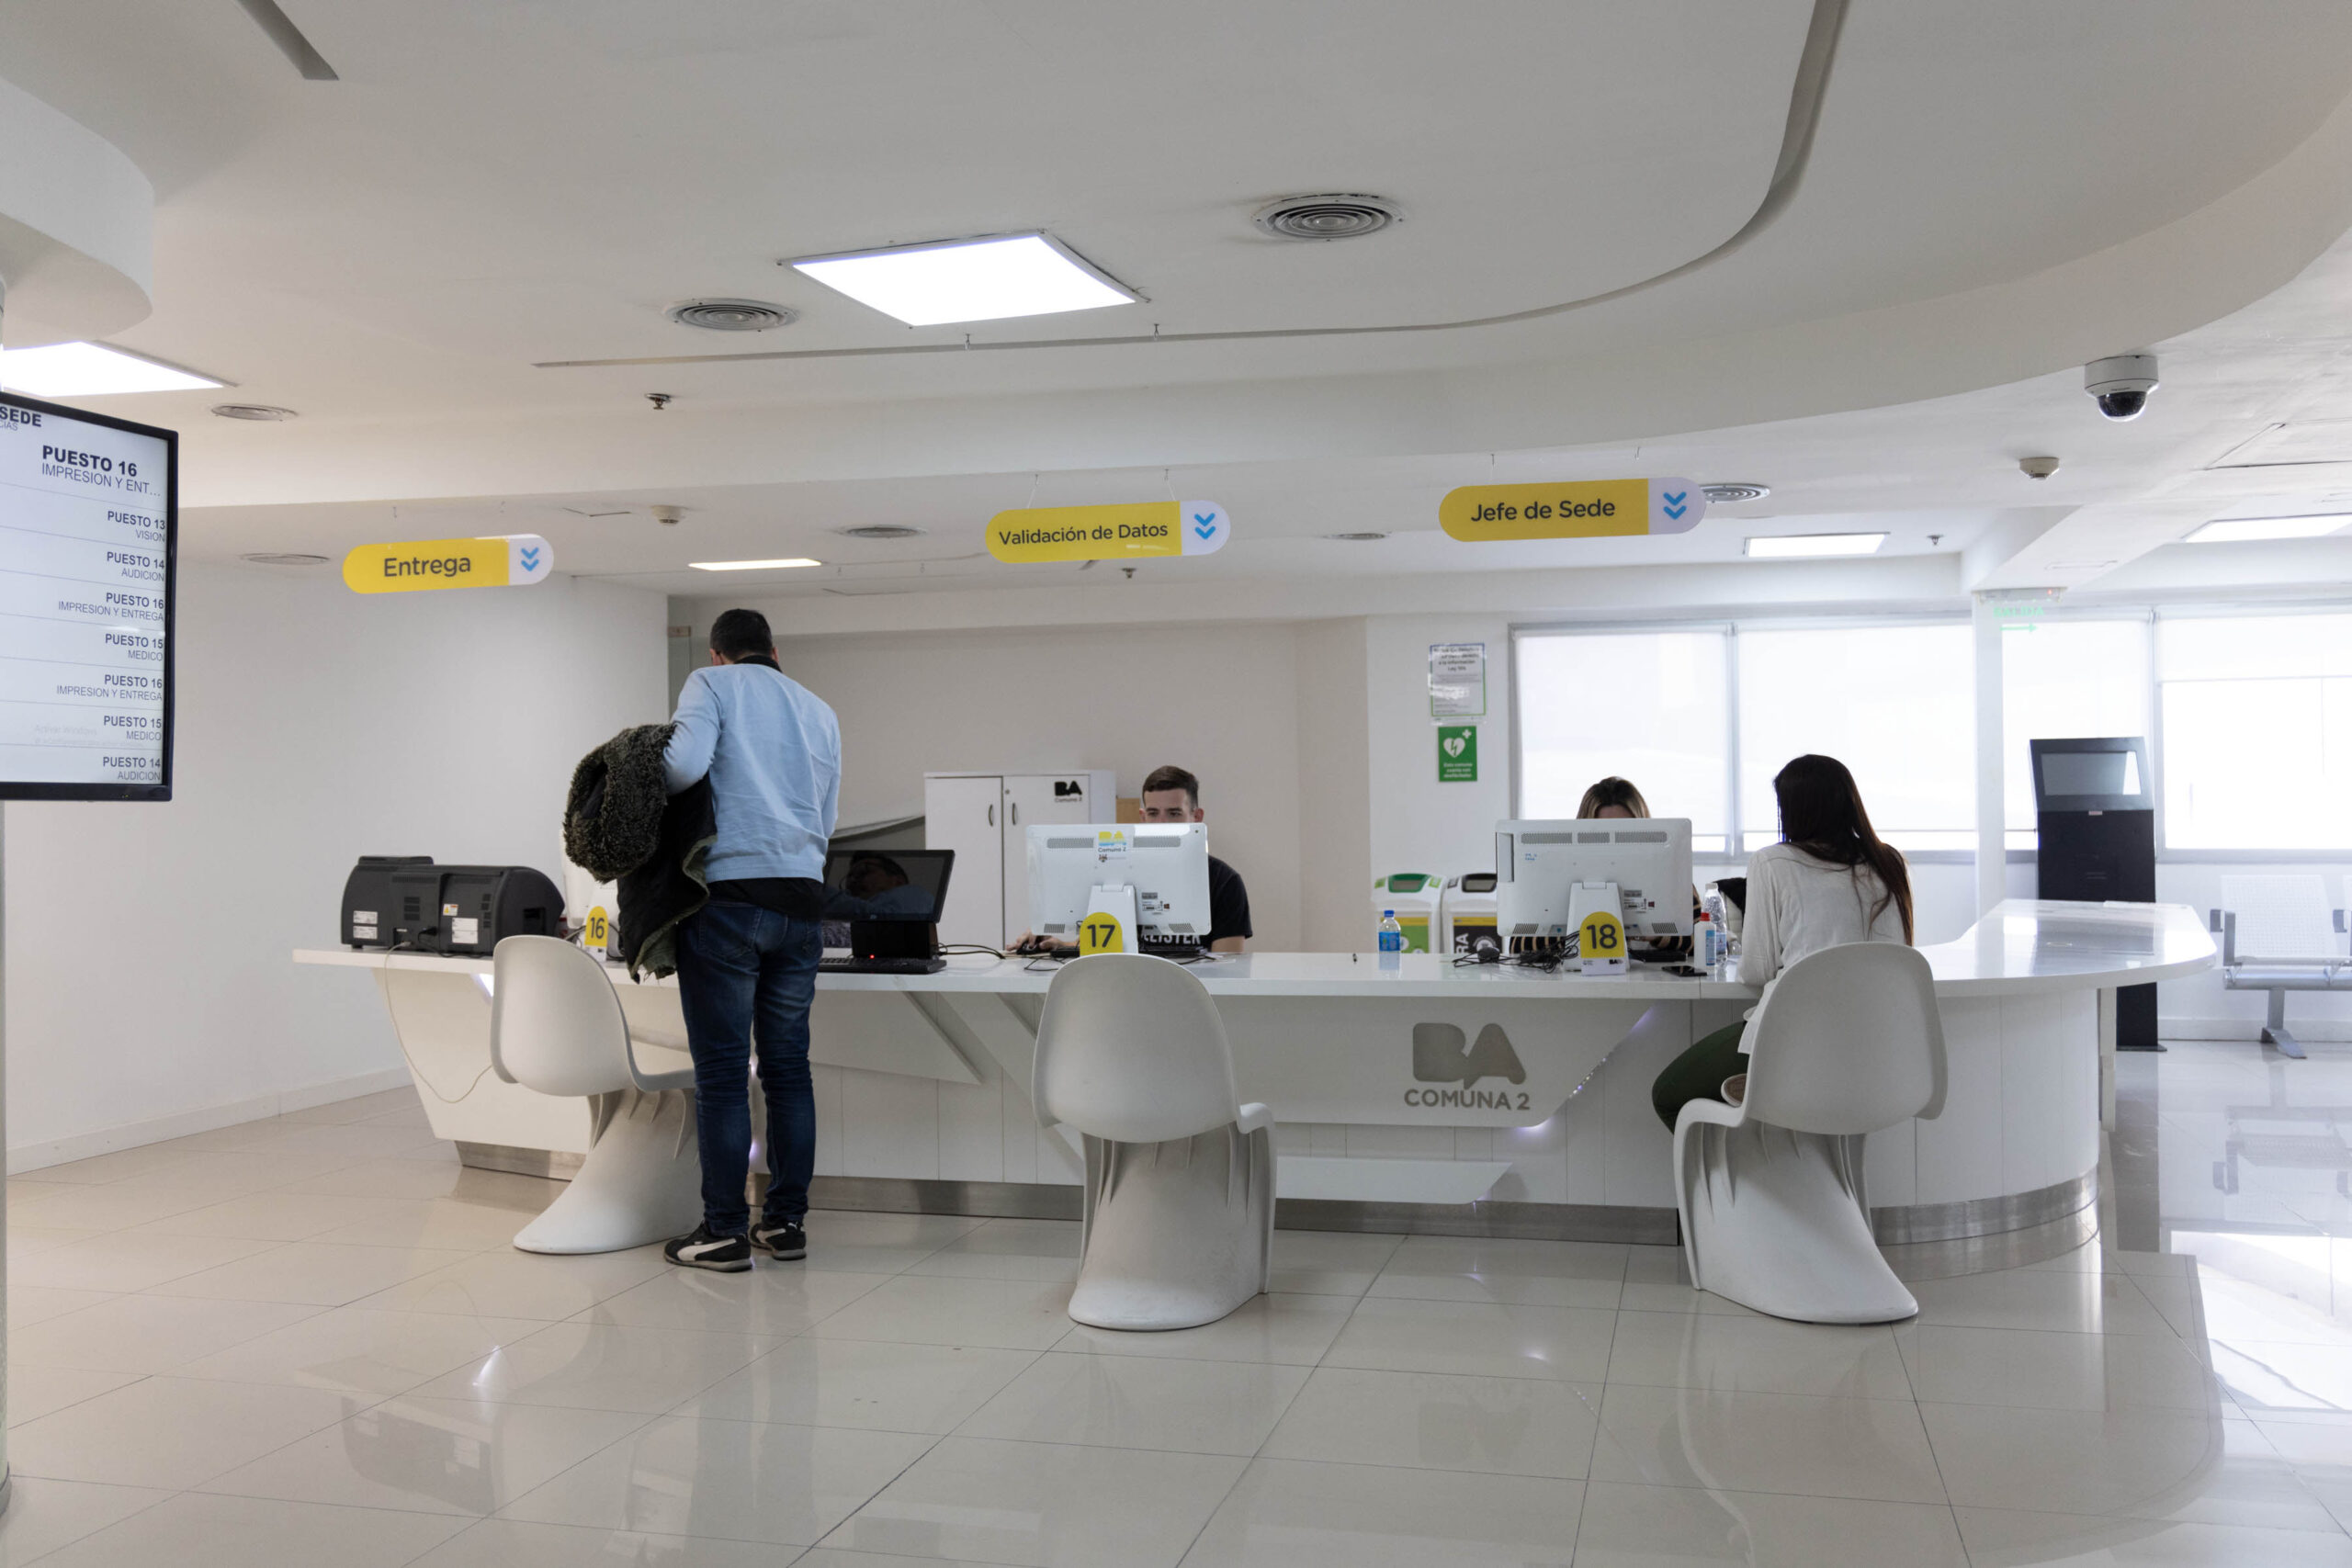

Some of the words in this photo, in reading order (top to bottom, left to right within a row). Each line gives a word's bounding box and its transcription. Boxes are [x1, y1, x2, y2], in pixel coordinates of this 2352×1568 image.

[0, 406, 42, 427] SEDE
[42, 445, 112, 472] PUESTO
[119, 461, 138, 477] 16
[42, 462, 112, 488] IMPRESION
[115, 477, 123, 489] Y
[1470, 502, 1517, 522] Jefe
[1524, 501, 1552, 519] de
[1559, 499, 1615, 518] Sede
[107, 511, 152, 528] PUESTO
[154, 519, 165, 530] 13
[136, 529, 165, 543] VISION
[999, 525, 1087, 546] Validación
[1091, 525, 1113, 540] de
[1118, 523, 1169, 539] Datos
[107, 551, 150, 568] PUESTO
[153, 558, 164, 570] 14
[384, 556, 471, 578] Entrega
[121, 567, 164, 581] AUDICION
[106, 592, 150, 608] PUESTO
[153, 598, 164, 609] 16
[59, 601, 111, 616] IMPRESION
[113, 607, 119, 616] Y
[121, 608, 164, 622] ENTREGA
[105, 633, 149, 649] PUESTO
[152, 638, 164, 649] 15
[128, 649, 164, 661] MEDICO
[105, 674, 148, 688] PUESTO
[151, 678, 163, 689] 16
[57, 685, 109, 698] IMPRESION
[111, 690, 118, 699] Y
[119, 689, 163, 701] ENTREGA
[104, 716, 147, 728] PUESTO
[150, 718, 162, 728] 15
[126, 730, 162, 740] MEDICO
[103, 757, 146, 768] PUESTO
[149, 758, 161, 768] 14
[118, 771, 161, 781] AUDICION
[1055, 781, 1082, 796] BA
[591, 917, 605, 939] 16
[1087, 924, 1115, 948] 17
[1586, 924, 1617, 949] 18
[1413, 1022, 1526, 1090] BA
[1404, 1089, 1511, 1111] COMUNA
[1517, 1093, 1530, 1111] 2
